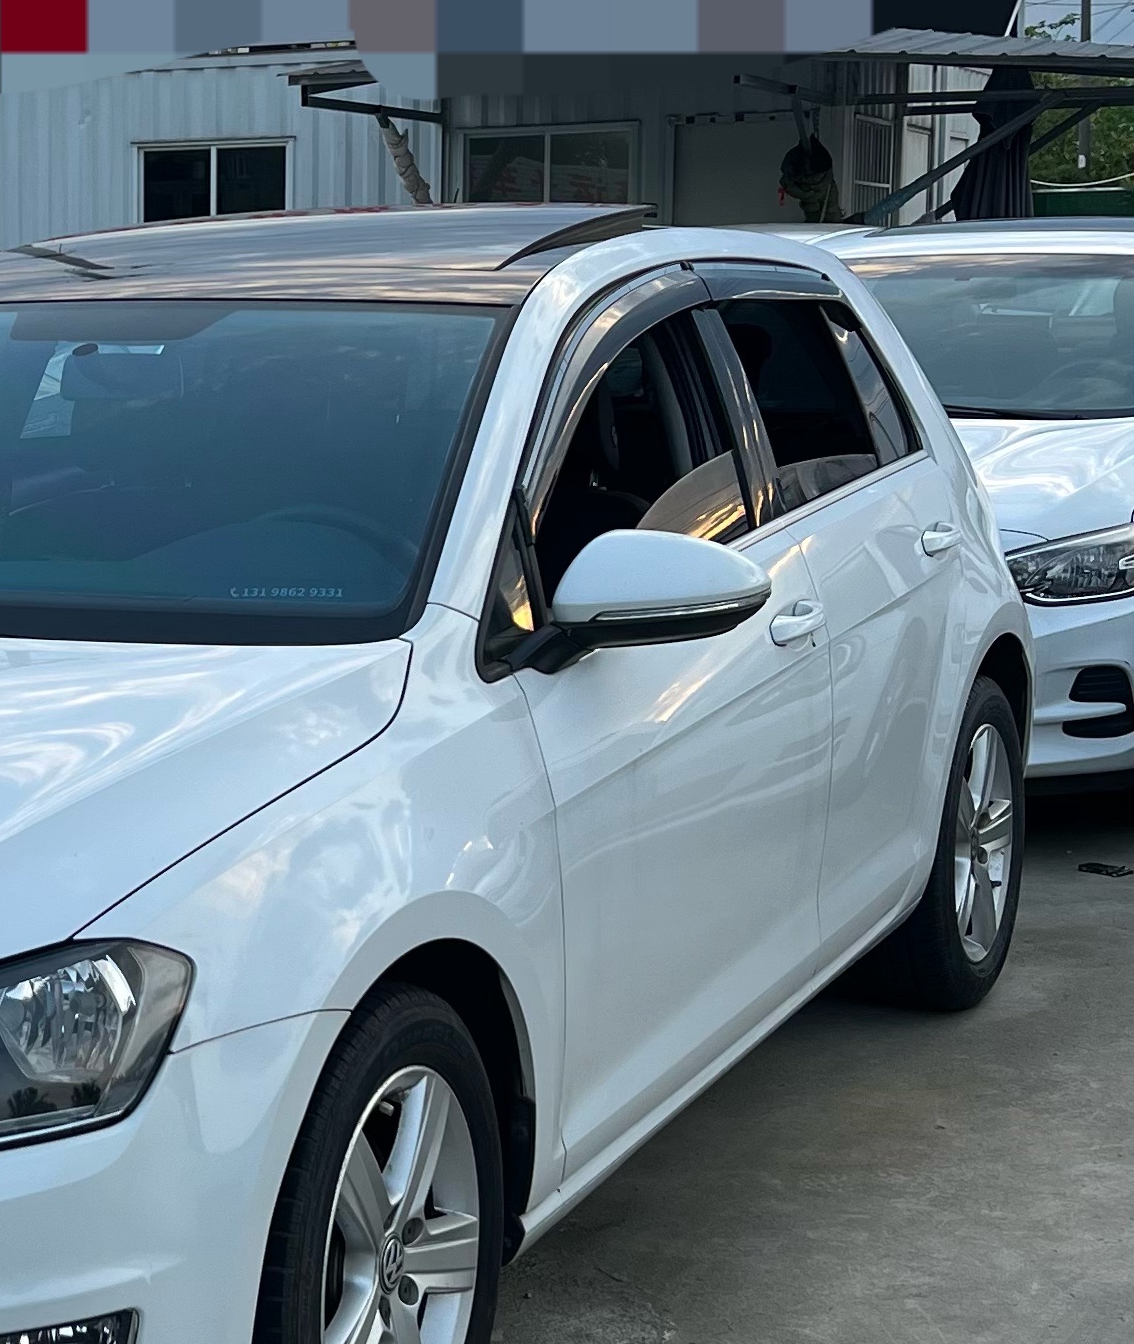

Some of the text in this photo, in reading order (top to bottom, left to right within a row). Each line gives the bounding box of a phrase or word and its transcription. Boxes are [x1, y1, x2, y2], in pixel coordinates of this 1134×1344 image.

[242, 587, 343, 597] 131 9862 9331
